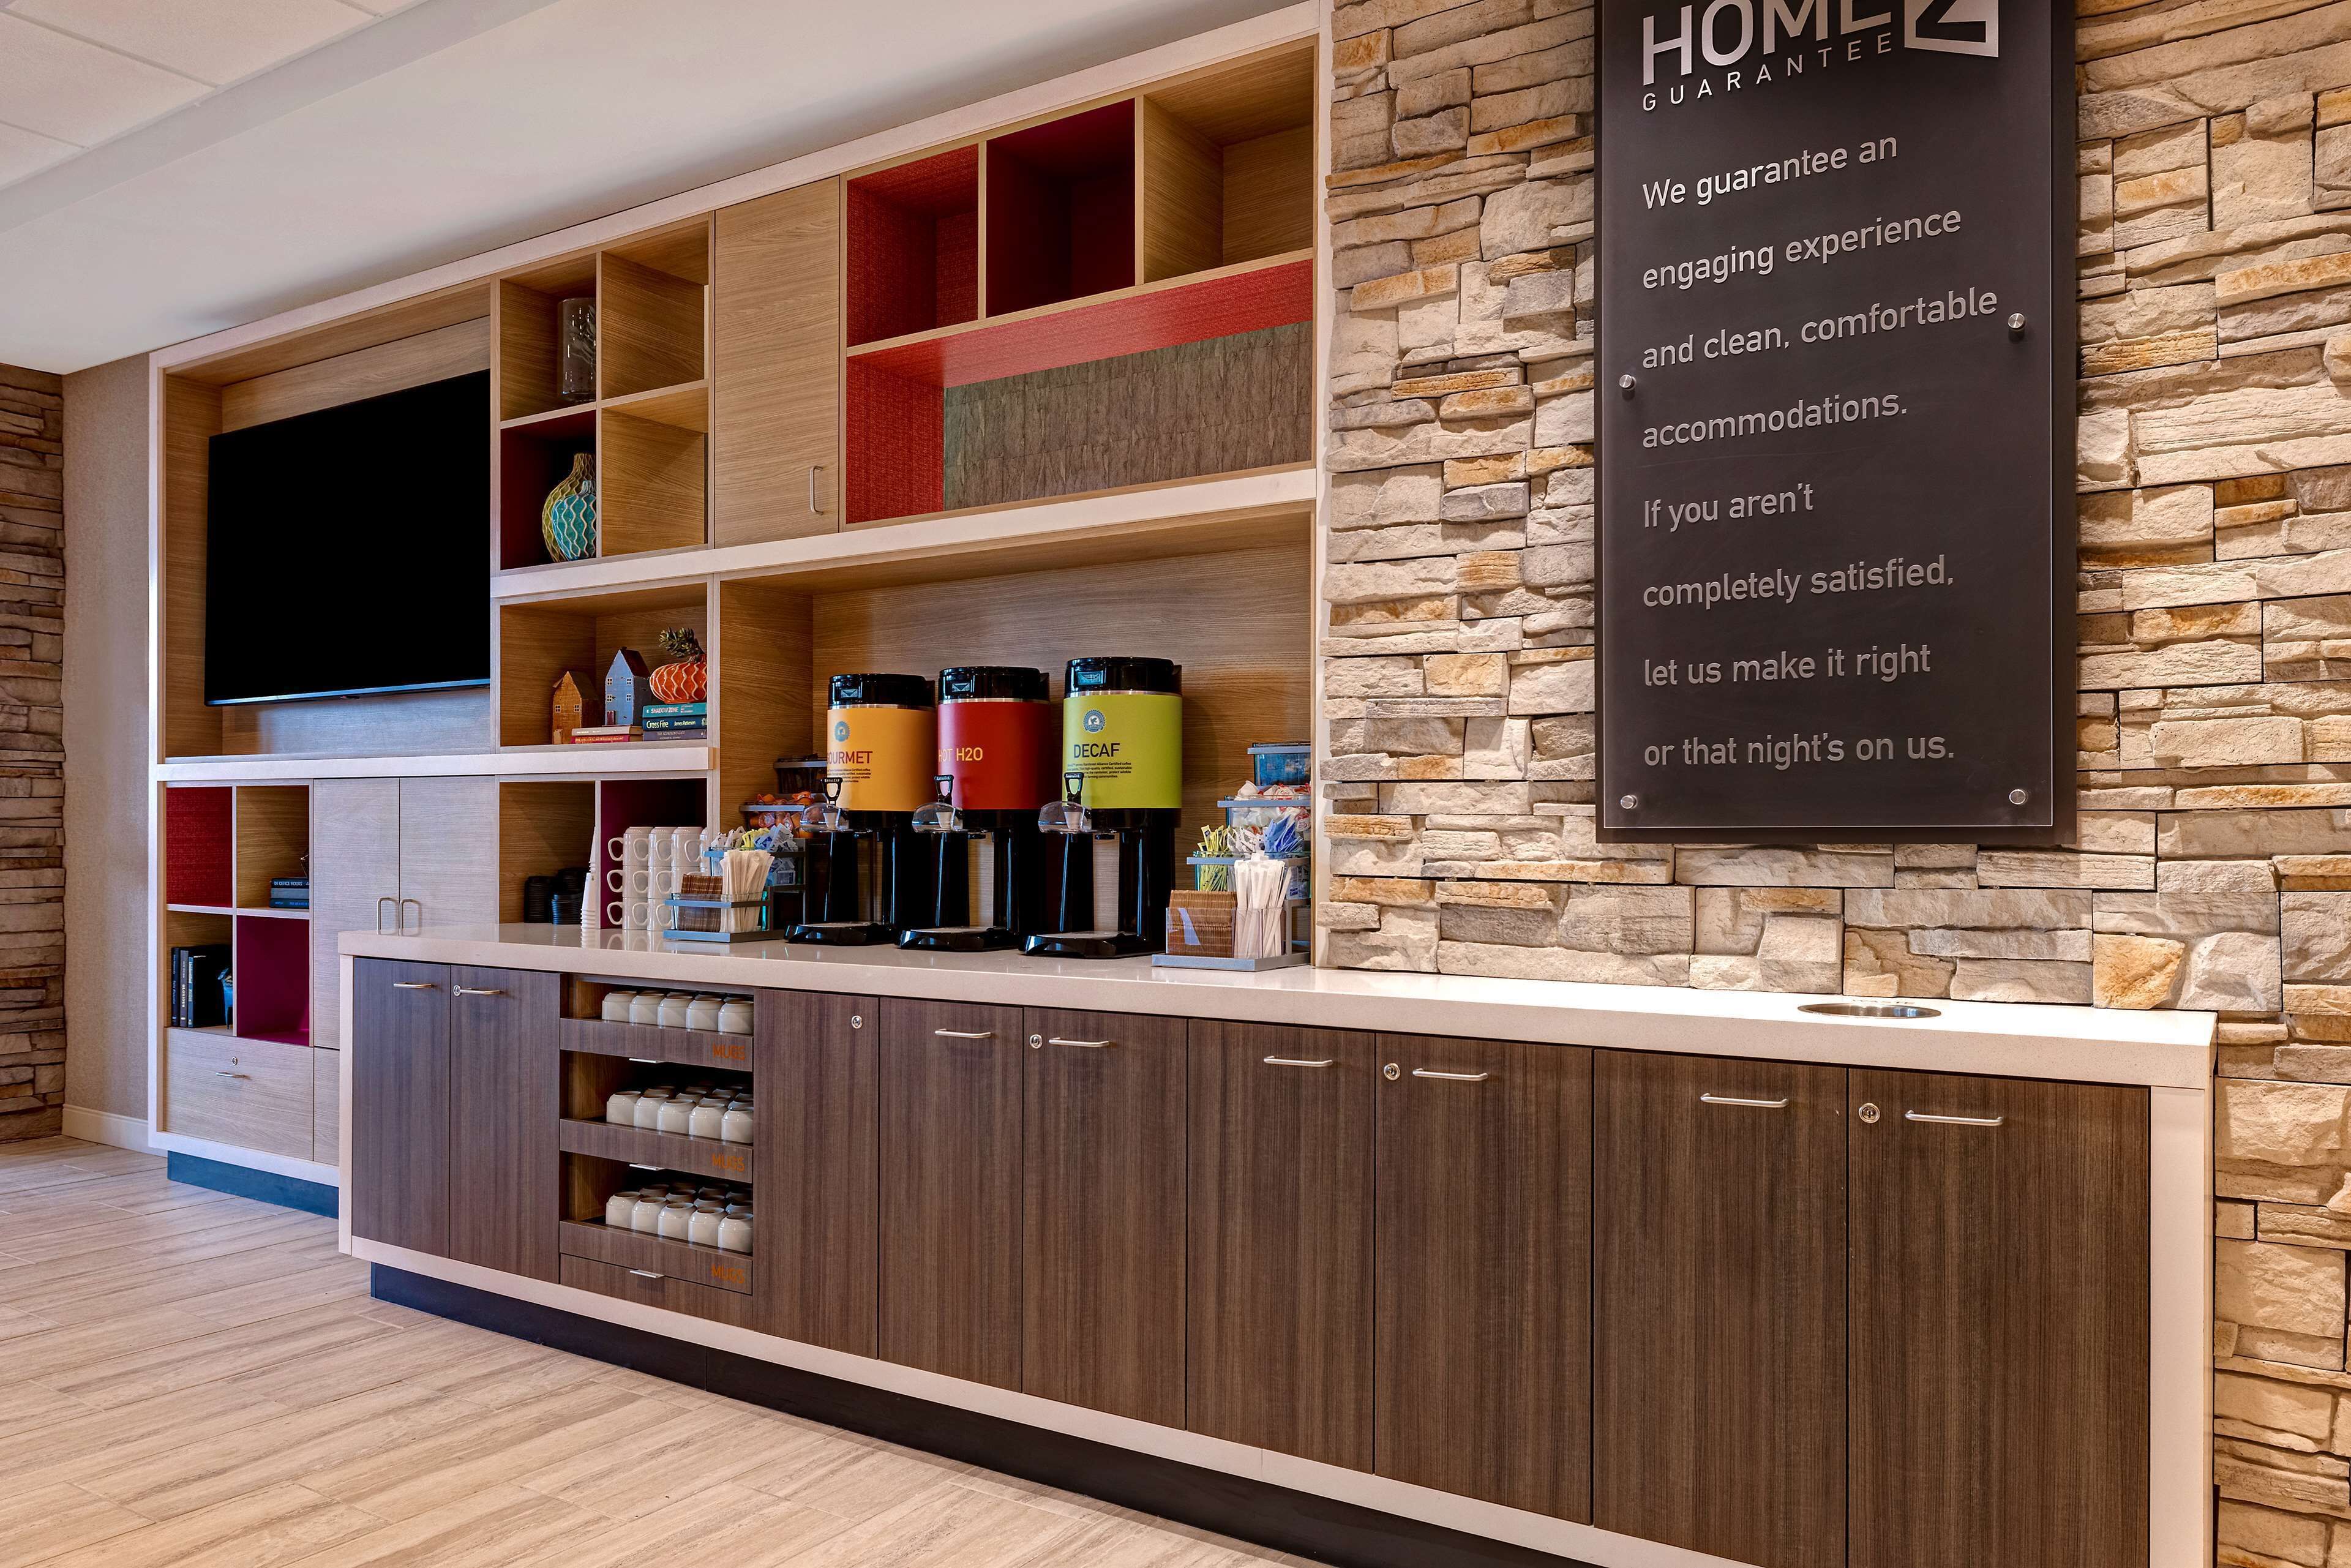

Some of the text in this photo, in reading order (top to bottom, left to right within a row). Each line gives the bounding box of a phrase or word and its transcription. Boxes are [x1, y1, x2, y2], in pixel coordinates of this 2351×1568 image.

[1643, 32, 1891, 111] GUARANTEE
[1643, 137, 1896, 209] We guarantee an
[1643, 211, 1960, 289] engaging experience
[1643, 287, 1997, 368] and clean, comfortable
[1643, 394, 1907, 448] accommodations.
[1645, 483, 1813, 532] If you aren't
[1643, 554, 1953, 609] completely satisfied,
[1645, 644, 1930, 686] let us make it right
[659, 719, 669, 728] Fire
[938, 747, 983, 763] HOT H2O
[1073, 743, 1120, 759] DECAF
[1644, 733, 1954, 770] or that night's on us.
[712, 1041, 745, 1061] MUGS
[711, 1152, 745, 1172] MUGS
[711, 1263, 745, 1284] MUGS
